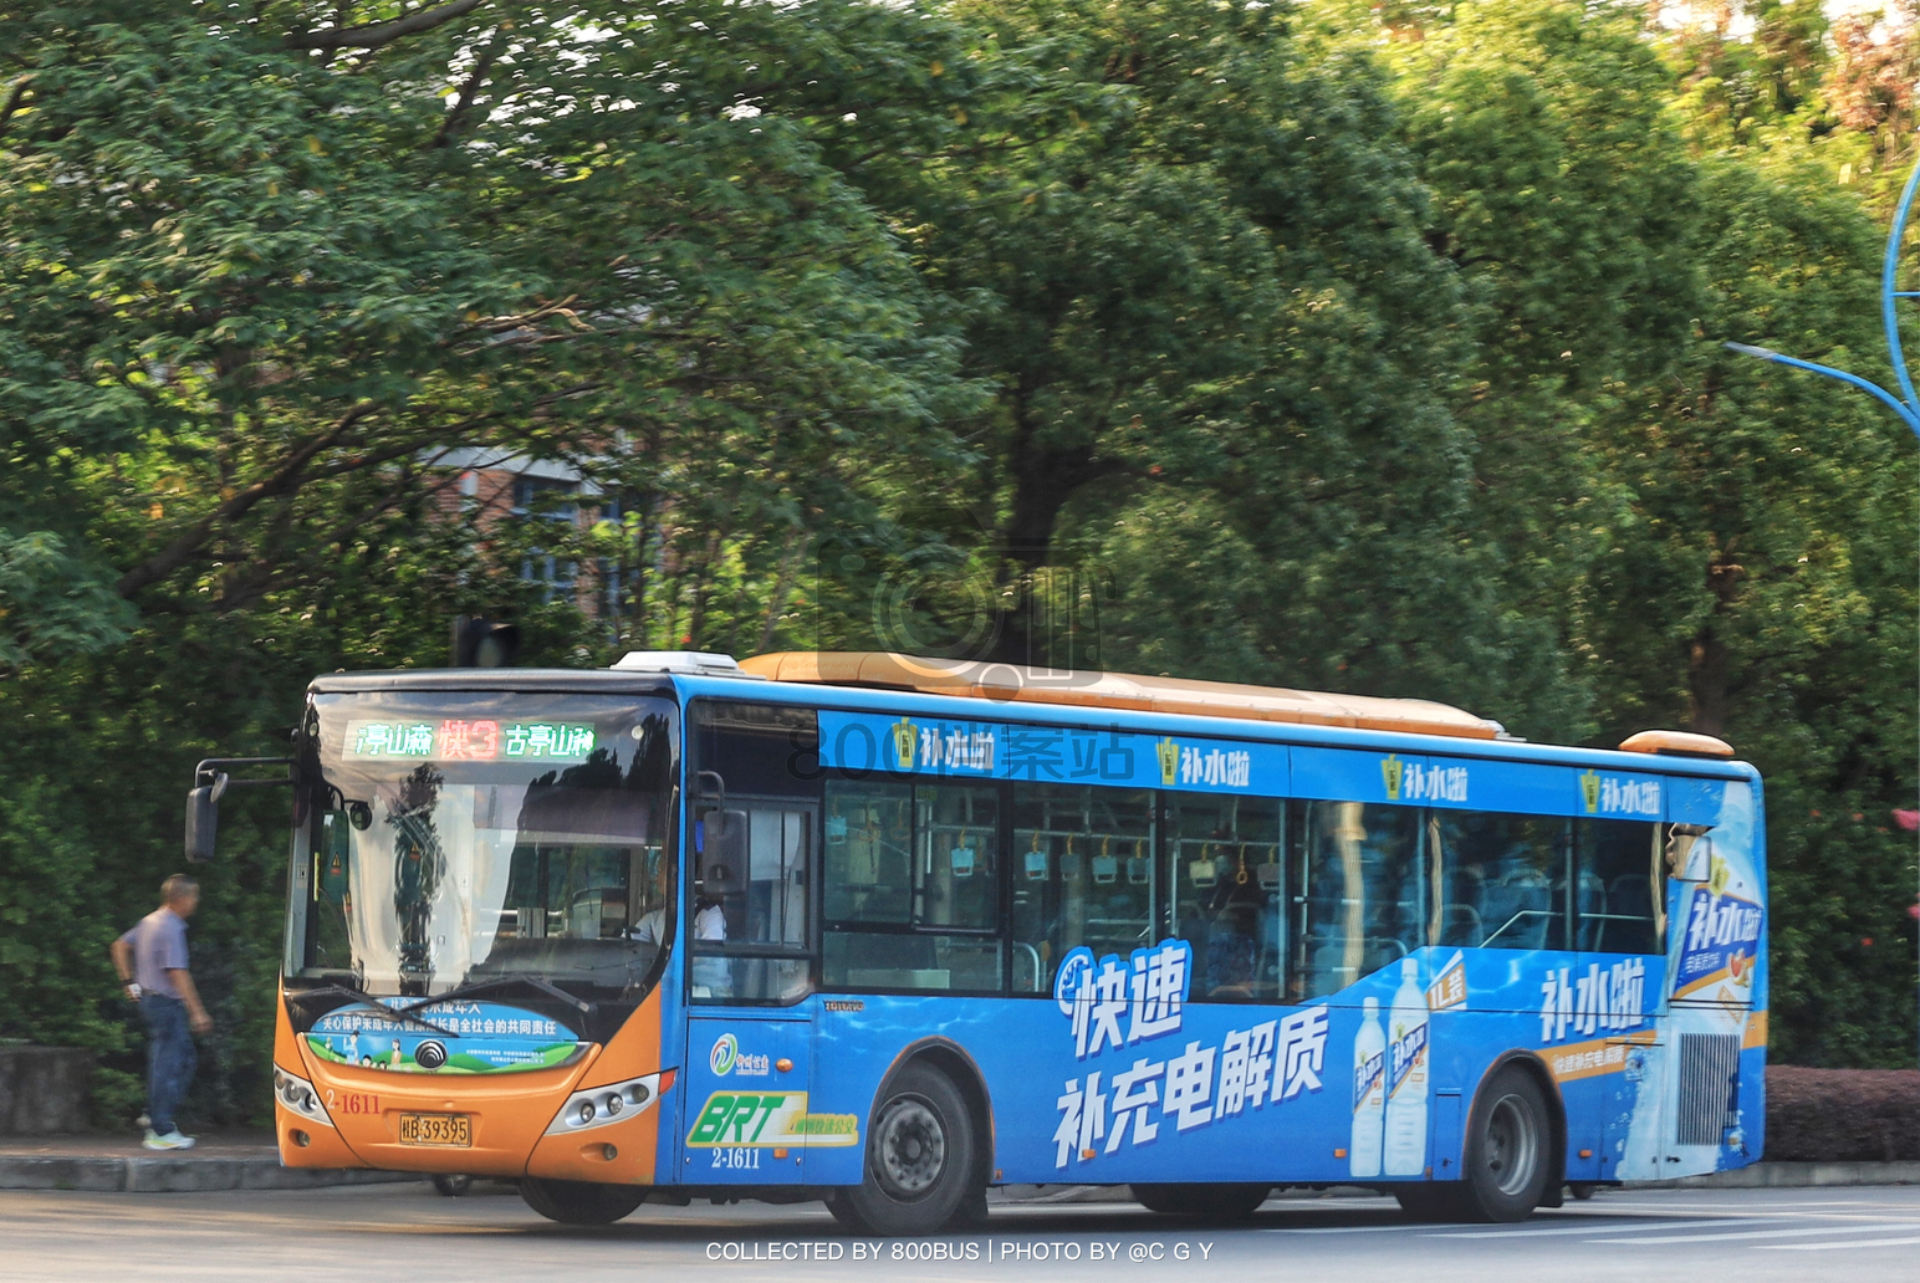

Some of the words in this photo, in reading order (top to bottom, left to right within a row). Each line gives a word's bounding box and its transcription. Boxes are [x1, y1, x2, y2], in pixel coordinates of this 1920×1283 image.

[438, 720, 498, 759] 快3
[920, 727, 995, 770] 补水啦
[1181, 746, 1250, 787] 补水啦
[1404, 763, 1468, 802] 补水啦
[1600, 777, 1660, 815] 补水啦
[1688, 892, 1763, 952] 补水啦
[1071, 945, 1186, 1058] 快速
[1430, 968, 1463, 1010] 1L装
[1540, 957, 1645, 1043] 补水啦
[326, 1088, 381, 1115] 2-1611
[1052, 1003, 1329, 1169] 补充电解质
[689, 1095, 786, 1142] BRT
[711, 1147, 760, 1169] 2-1611
